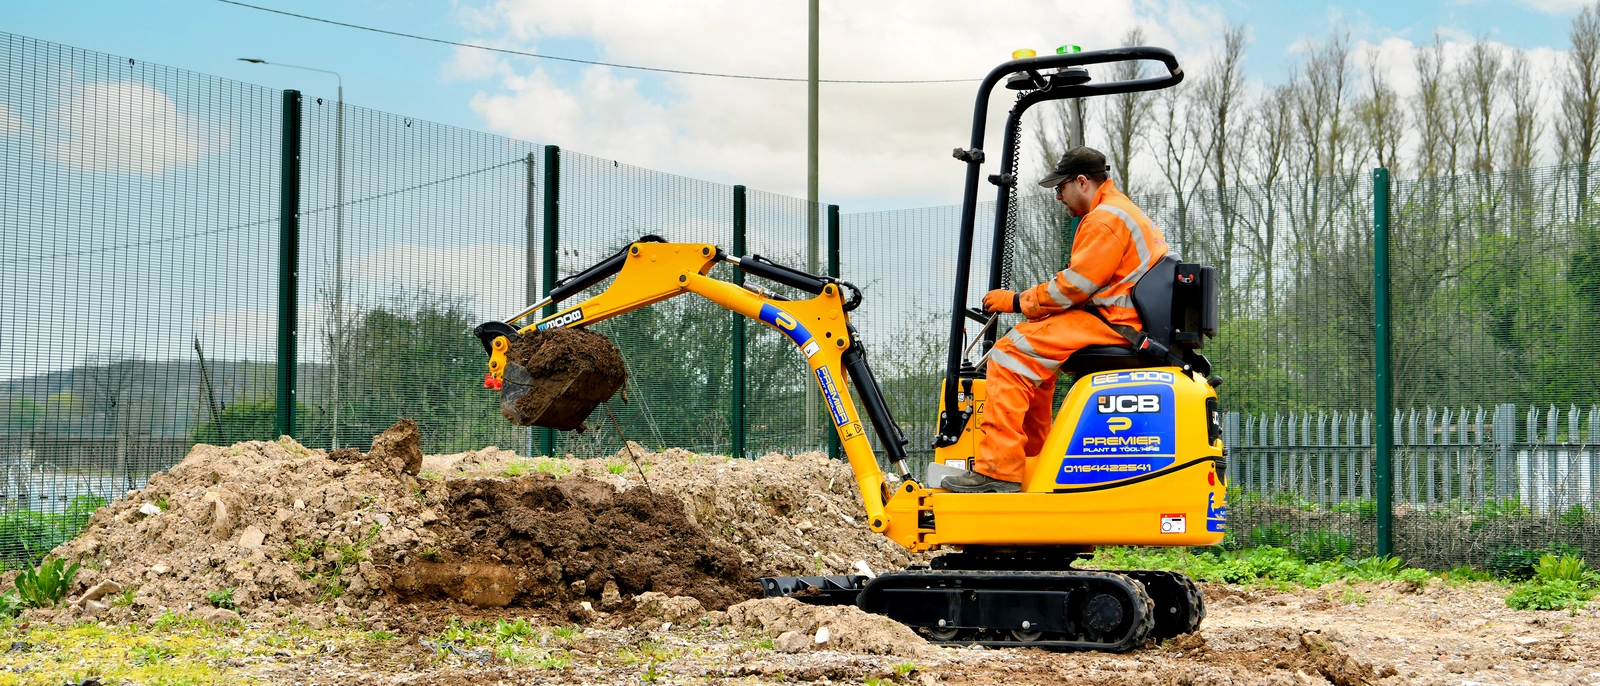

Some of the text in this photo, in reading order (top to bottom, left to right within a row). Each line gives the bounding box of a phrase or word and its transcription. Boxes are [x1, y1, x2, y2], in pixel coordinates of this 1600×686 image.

[1093, 371, 1173, 385] EE-1000
[820, 366, 848, 423] PREMIER
[1098, 395, 1160, 413] JCB
[1083, 436, 1161, 446] PREMIER
[1063, 463, 1152, 473] 01164422541
